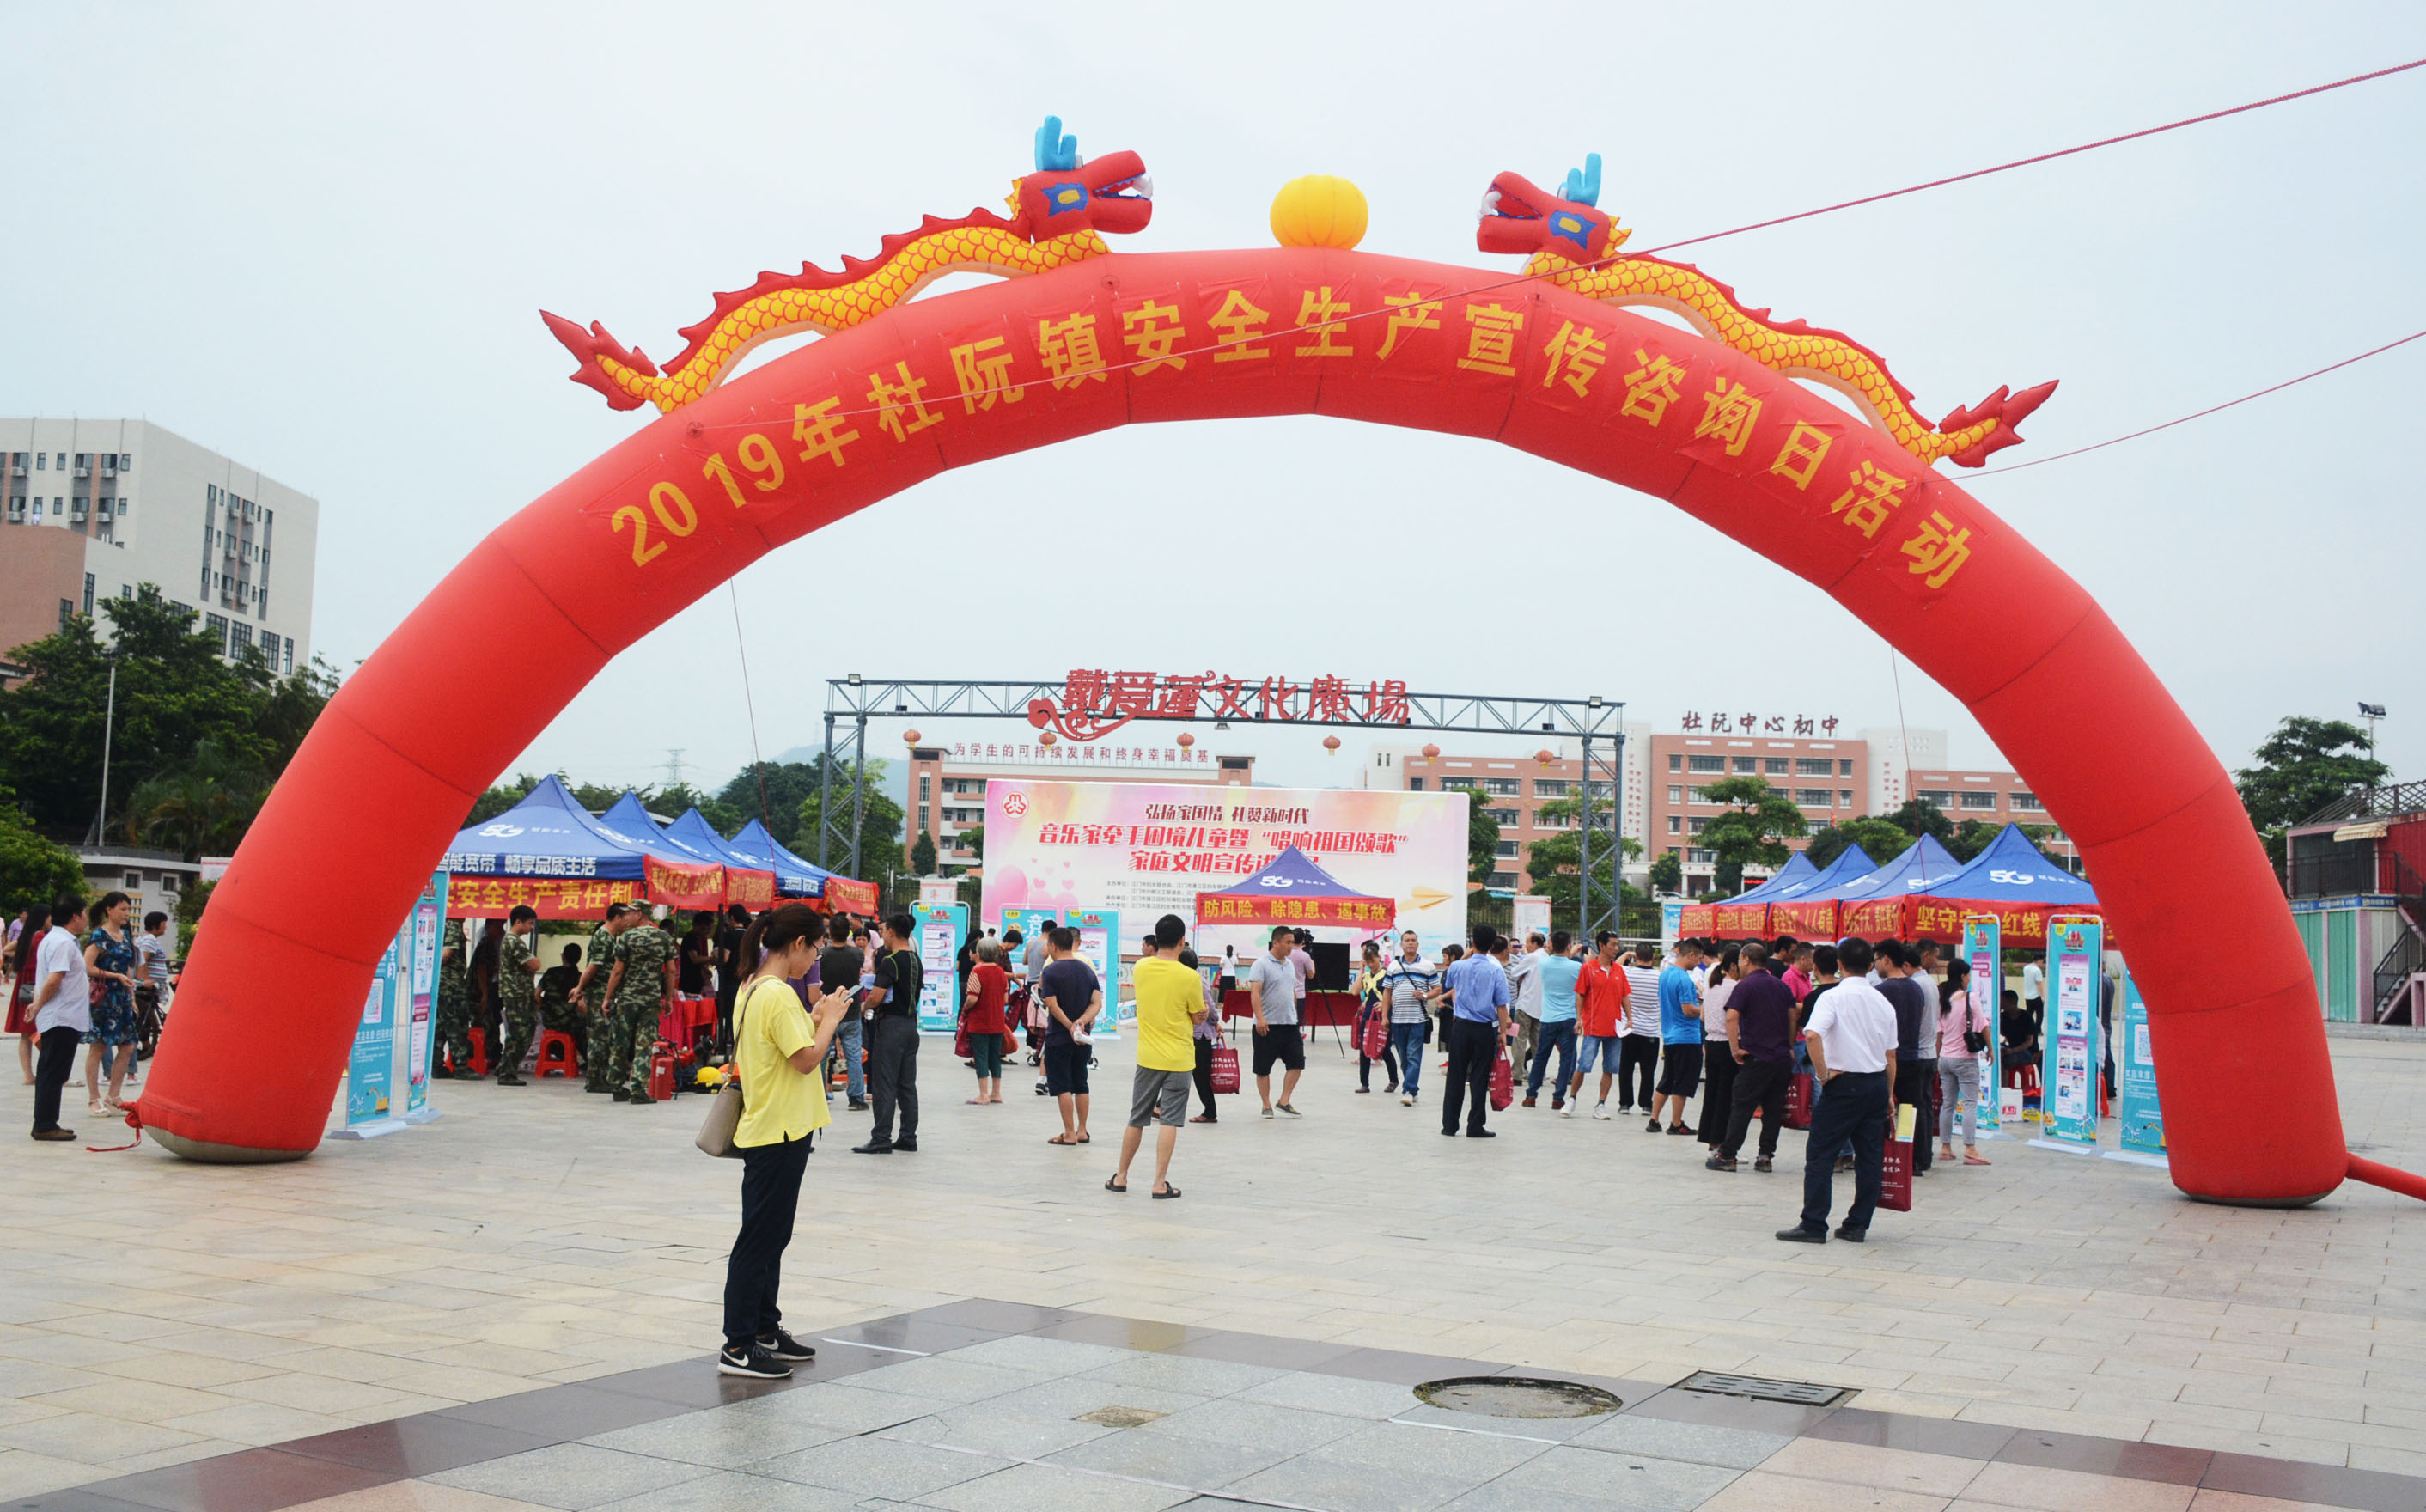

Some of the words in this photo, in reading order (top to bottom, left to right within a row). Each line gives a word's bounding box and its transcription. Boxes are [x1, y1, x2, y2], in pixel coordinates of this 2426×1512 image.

[610, 286, 1972, 588] 2019年杜阮镇安全生产宣传咨询日活动
[1682, 710, 1839, 737] 杜阮中心初中
[954, 742, 1208, 763] 为学生的可持续发展和终身幸福奠基
